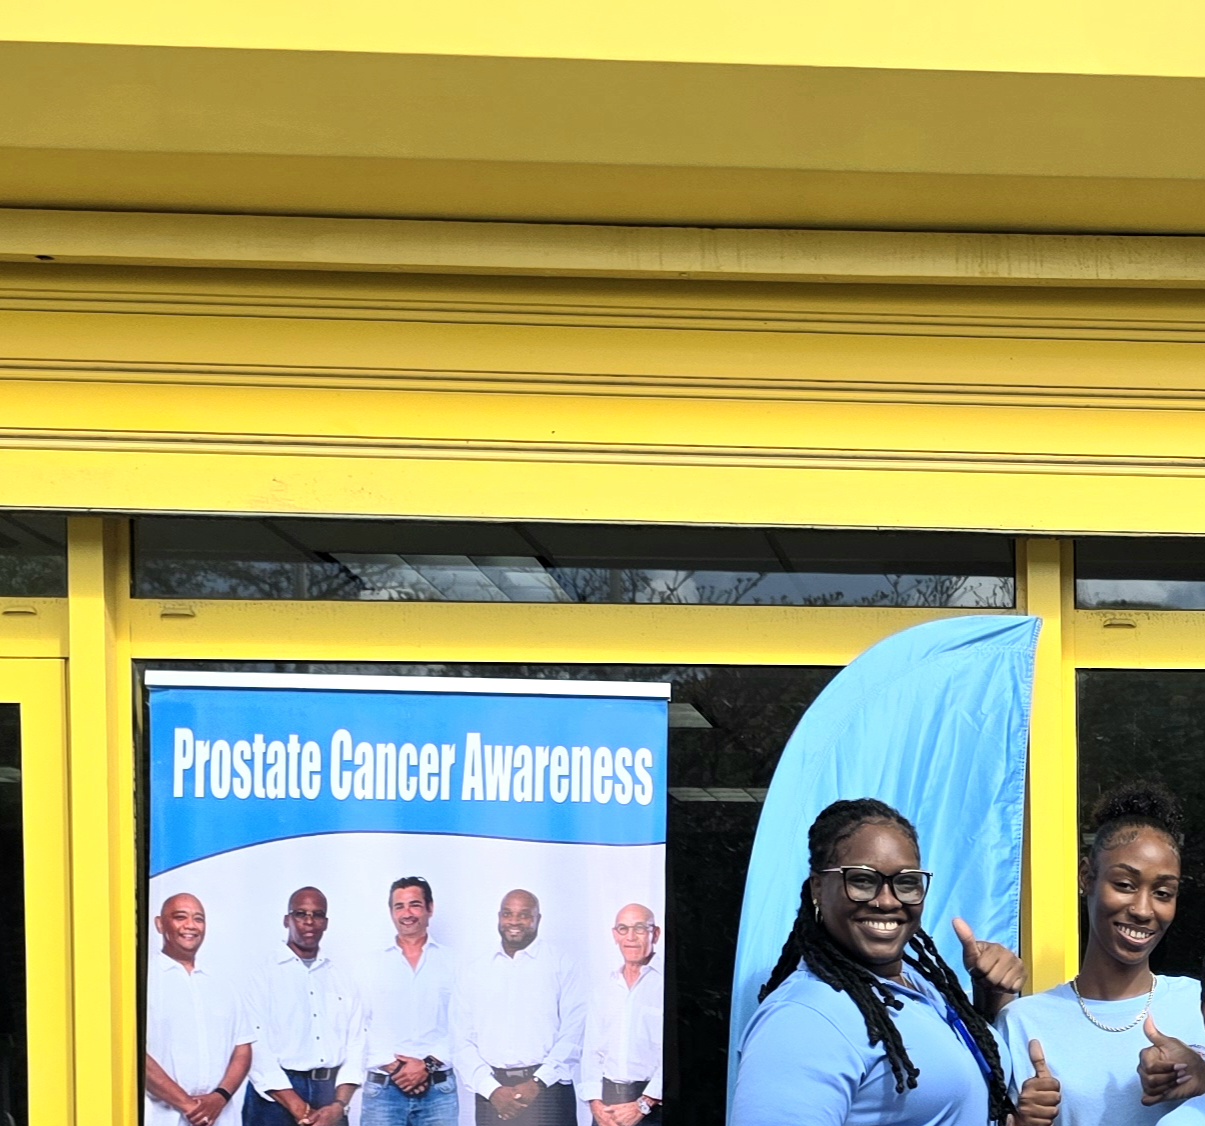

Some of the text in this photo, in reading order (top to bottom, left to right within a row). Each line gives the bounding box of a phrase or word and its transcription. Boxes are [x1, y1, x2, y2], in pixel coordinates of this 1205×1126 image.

[173, 727, 655, 806] Prostate Cancer Awareness
